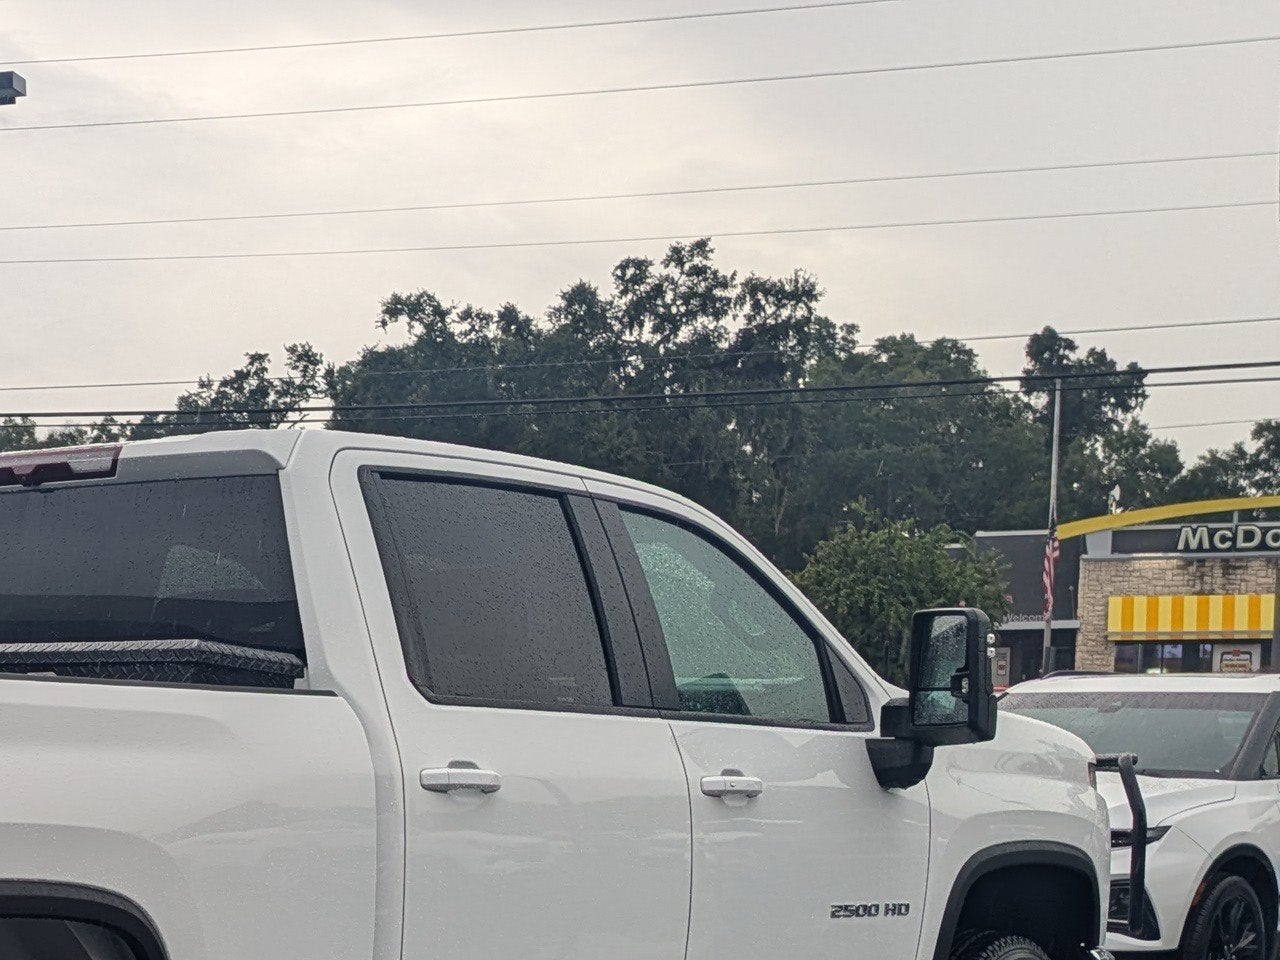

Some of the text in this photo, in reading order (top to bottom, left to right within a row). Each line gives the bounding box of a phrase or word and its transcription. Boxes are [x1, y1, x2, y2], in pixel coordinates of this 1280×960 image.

[1003, 612, 1048, 622] Welcom
[829, 902, 911, 919] 2500 HD
